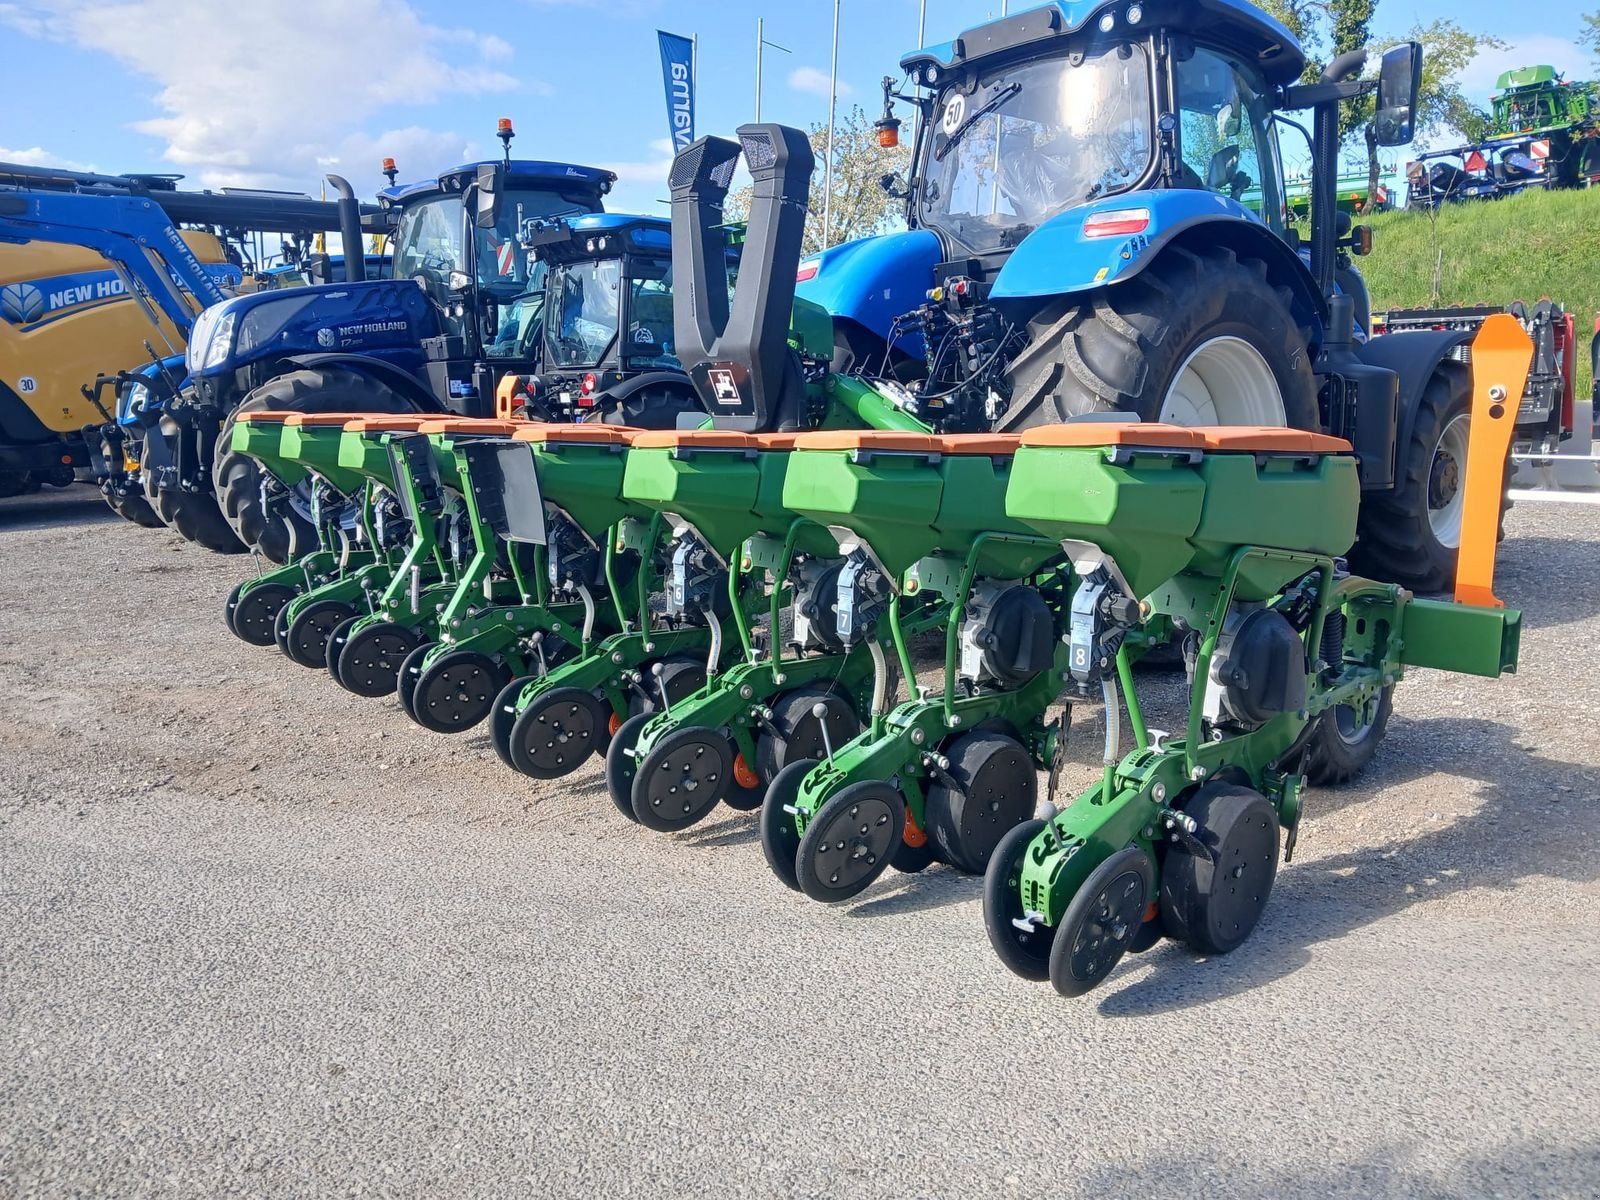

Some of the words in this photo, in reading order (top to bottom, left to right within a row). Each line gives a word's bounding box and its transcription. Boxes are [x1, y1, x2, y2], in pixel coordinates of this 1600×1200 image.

[946, 101, 961, 126] 50
[163, 225, 188, 254] NEW
[49, 284, 92, 310] NEW
[97, 280, 129, 297] HO
[339, 324, 363, 336] NEW
[364, 321, 407, 333] HOLLAND
[21, 379, 34, 391] 30
[675, 587, 682, 600] 6
[841, 613, 848, 628] 7
[1076, 648, 1085, 665] 8
